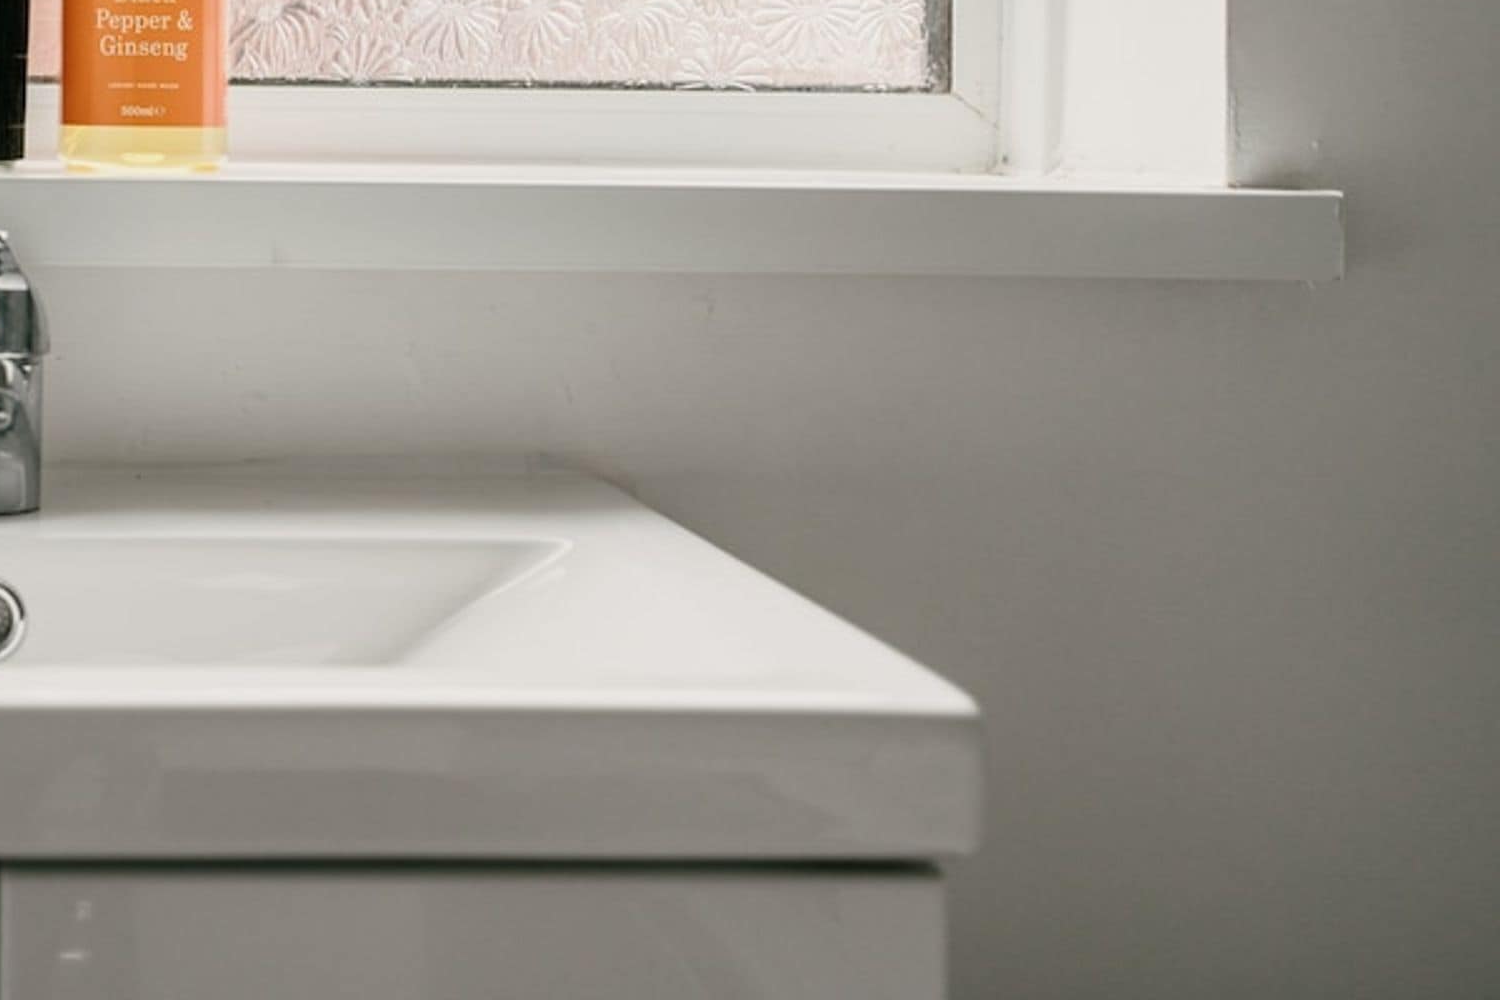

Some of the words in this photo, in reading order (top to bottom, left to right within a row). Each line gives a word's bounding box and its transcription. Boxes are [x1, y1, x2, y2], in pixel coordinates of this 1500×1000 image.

[96, 8, 171, 34] Pepper
[177, 10, 194, 30] &
[99, 35, 189, 61] Ginseng
